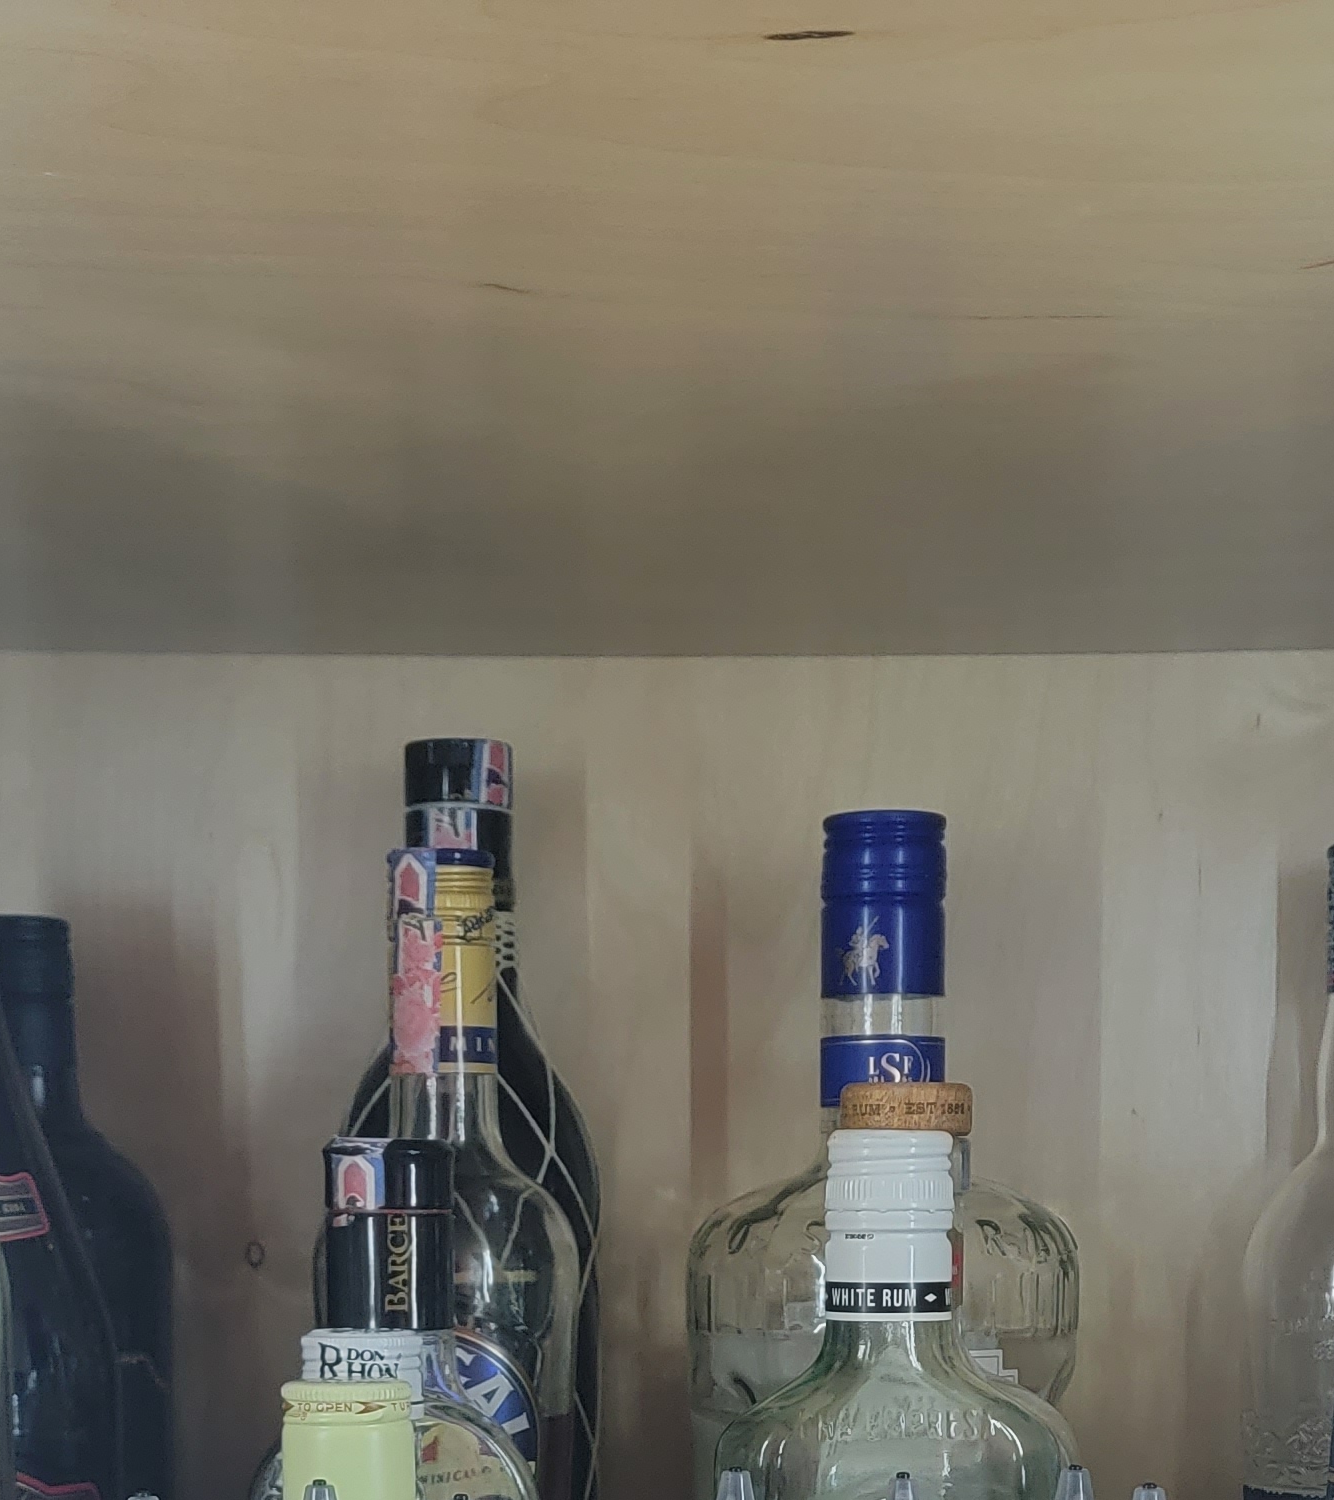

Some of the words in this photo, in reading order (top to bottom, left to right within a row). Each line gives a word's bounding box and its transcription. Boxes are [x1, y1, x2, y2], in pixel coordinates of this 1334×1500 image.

[383, 1214, 413, 1313] BARCE
[831, 1287, 876, 1307] WHITE
[882, 1287, 918, 1307] RUM
[297, 1402, 311, 1412] TO
[316, 1402, 353, 1412] OPEN
